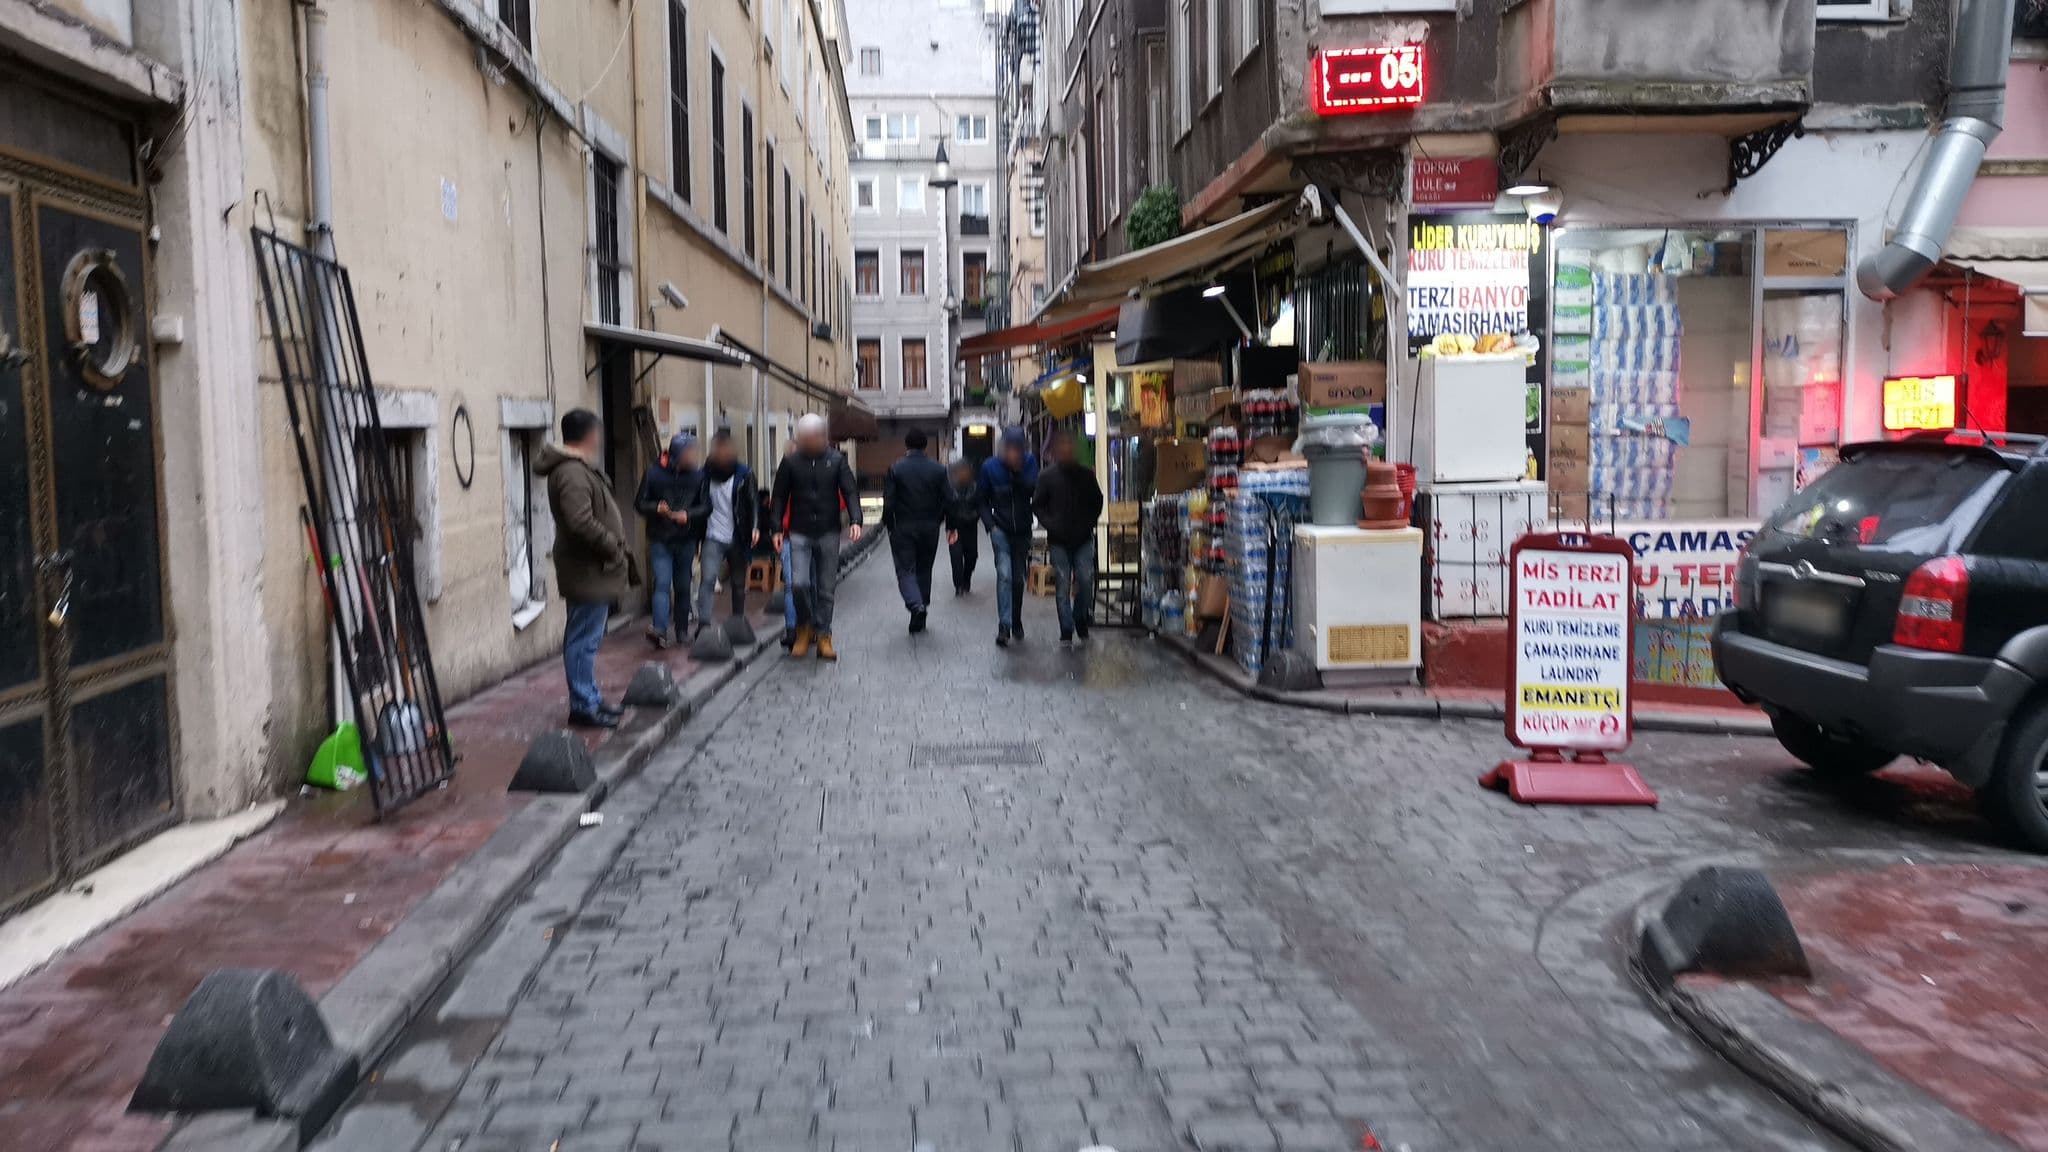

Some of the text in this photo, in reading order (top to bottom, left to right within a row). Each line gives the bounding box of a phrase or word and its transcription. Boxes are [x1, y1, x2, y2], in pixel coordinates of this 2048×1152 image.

[1416, 160, 1461, 175] TOPRAK
[1415, 178, 1443, 191] LULE
[1413, 220, 1454, 251] LİDER
[1408, 248, 1446, 272] KURU
[1407, 280, 1455, 309] TERZİ
[1523, 559, 1559, 581] MİS
[1567, 562, 1621, 584] TERZİ
[1525, 587, 1620, 610] TADİLAT
[1524, 619, 1620, 639] KURU TEMİZLEME
[1524, 642, 1620, 663] ÇAMAŞIRHANE
[1541, 665, 1601, 682] LAUNDRY
[1523, 687, 1620, 710] EMANETÇİ
[1523, 712, 1569, 734] KÜÇÜK
